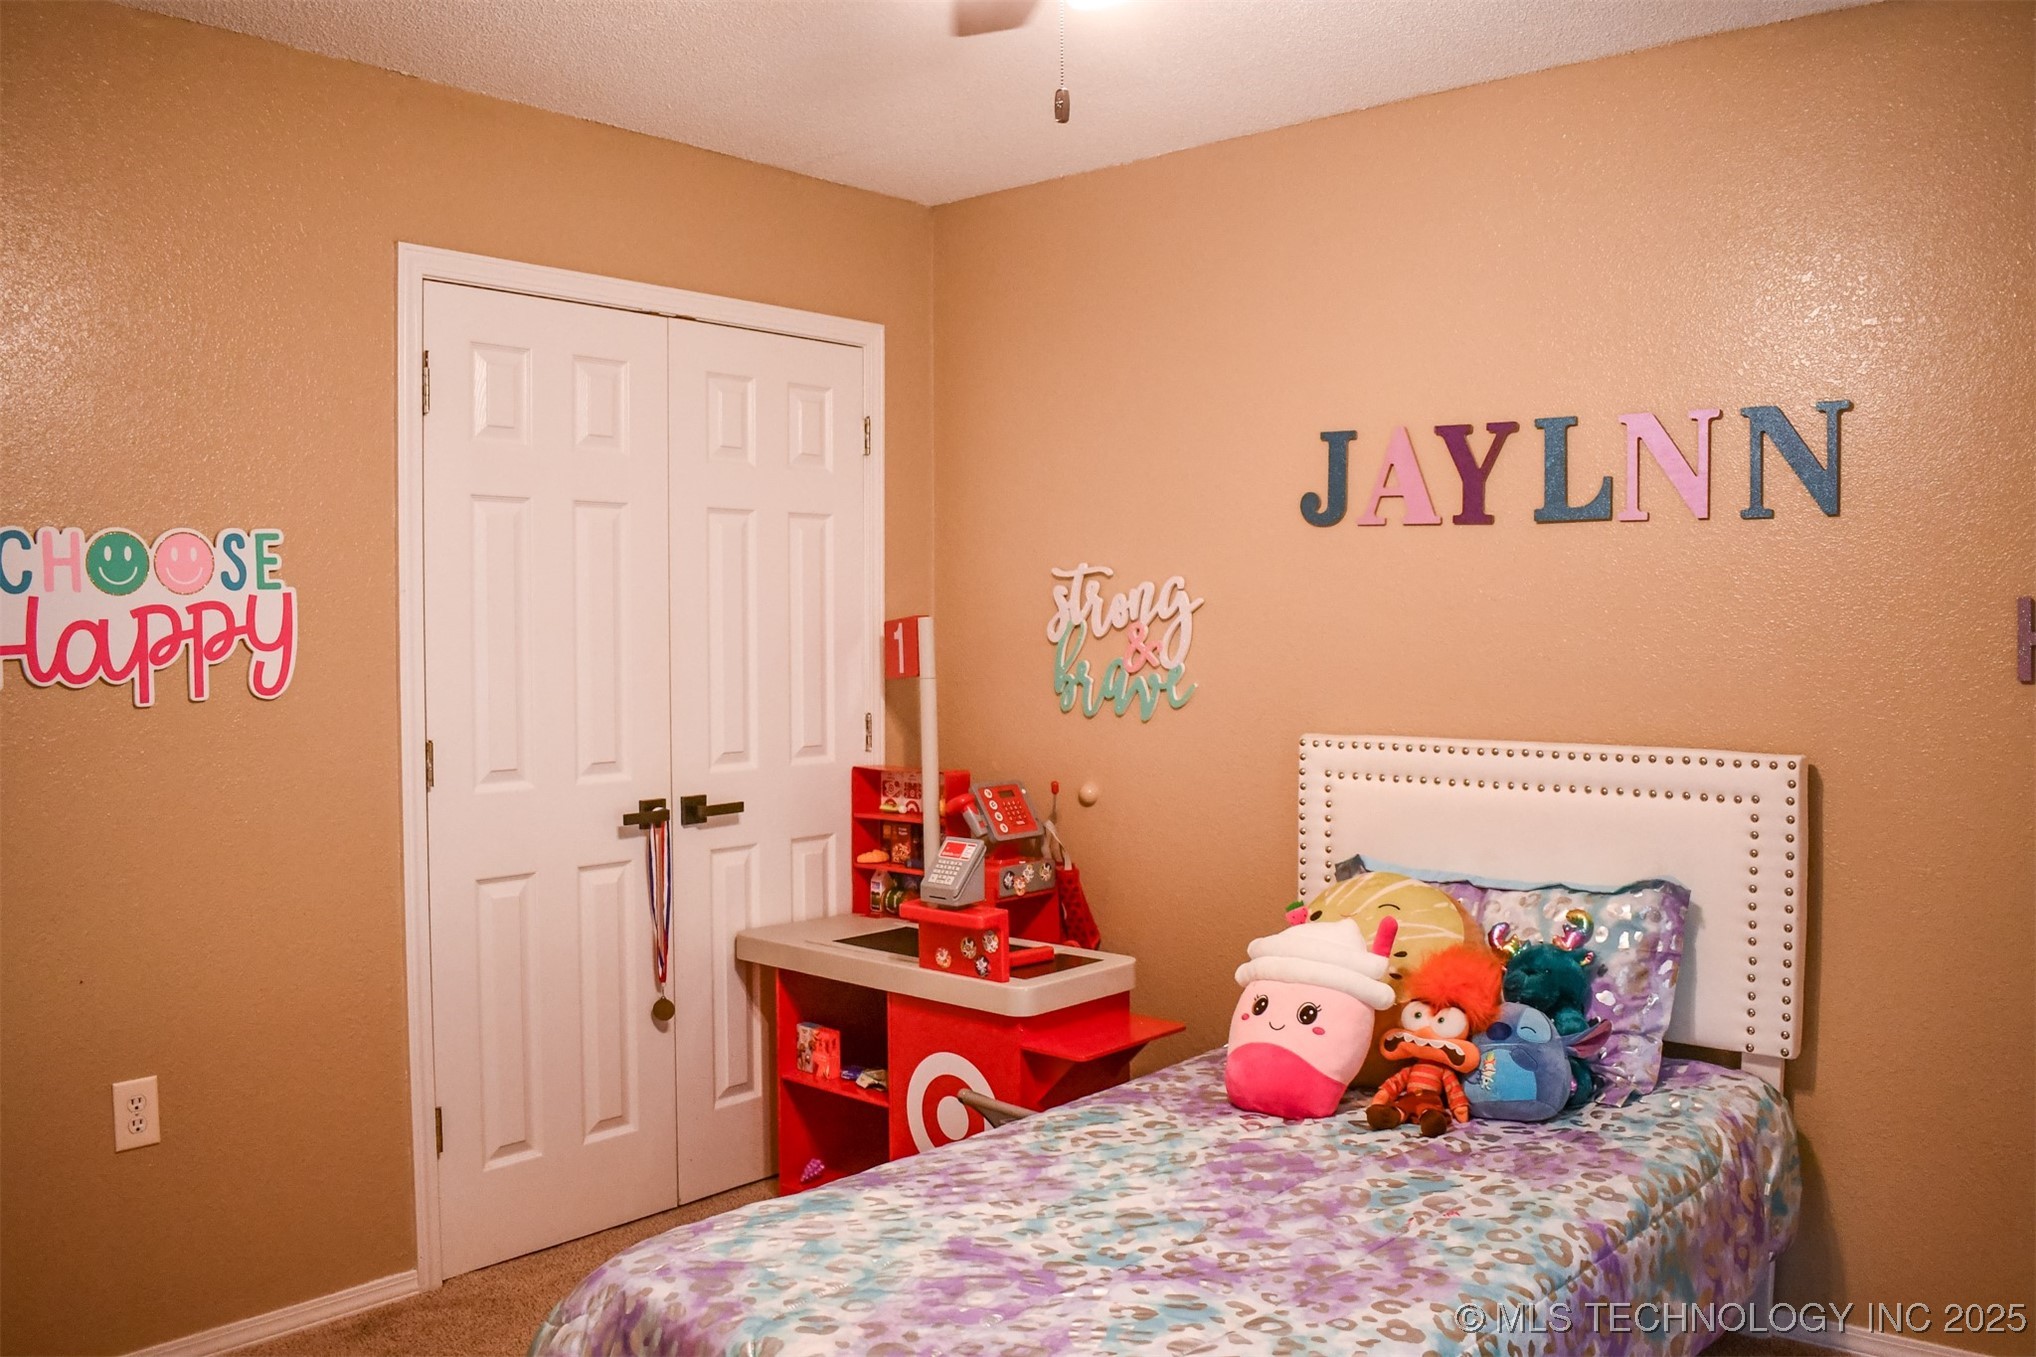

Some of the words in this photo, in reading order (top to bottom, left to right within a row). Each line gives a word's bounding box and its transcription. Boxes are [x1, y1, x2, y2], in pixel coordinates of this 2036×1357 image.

[1300, 400, 1851, 527] JAYLNN
[0, 529, 282, 596] CHOOSE
[893, 622, 905, 674] 1
[1047, 562, 1205, 670] strong
[1123, 620, 1163, 673] &
[1054, 620, 1198, 722] brave
